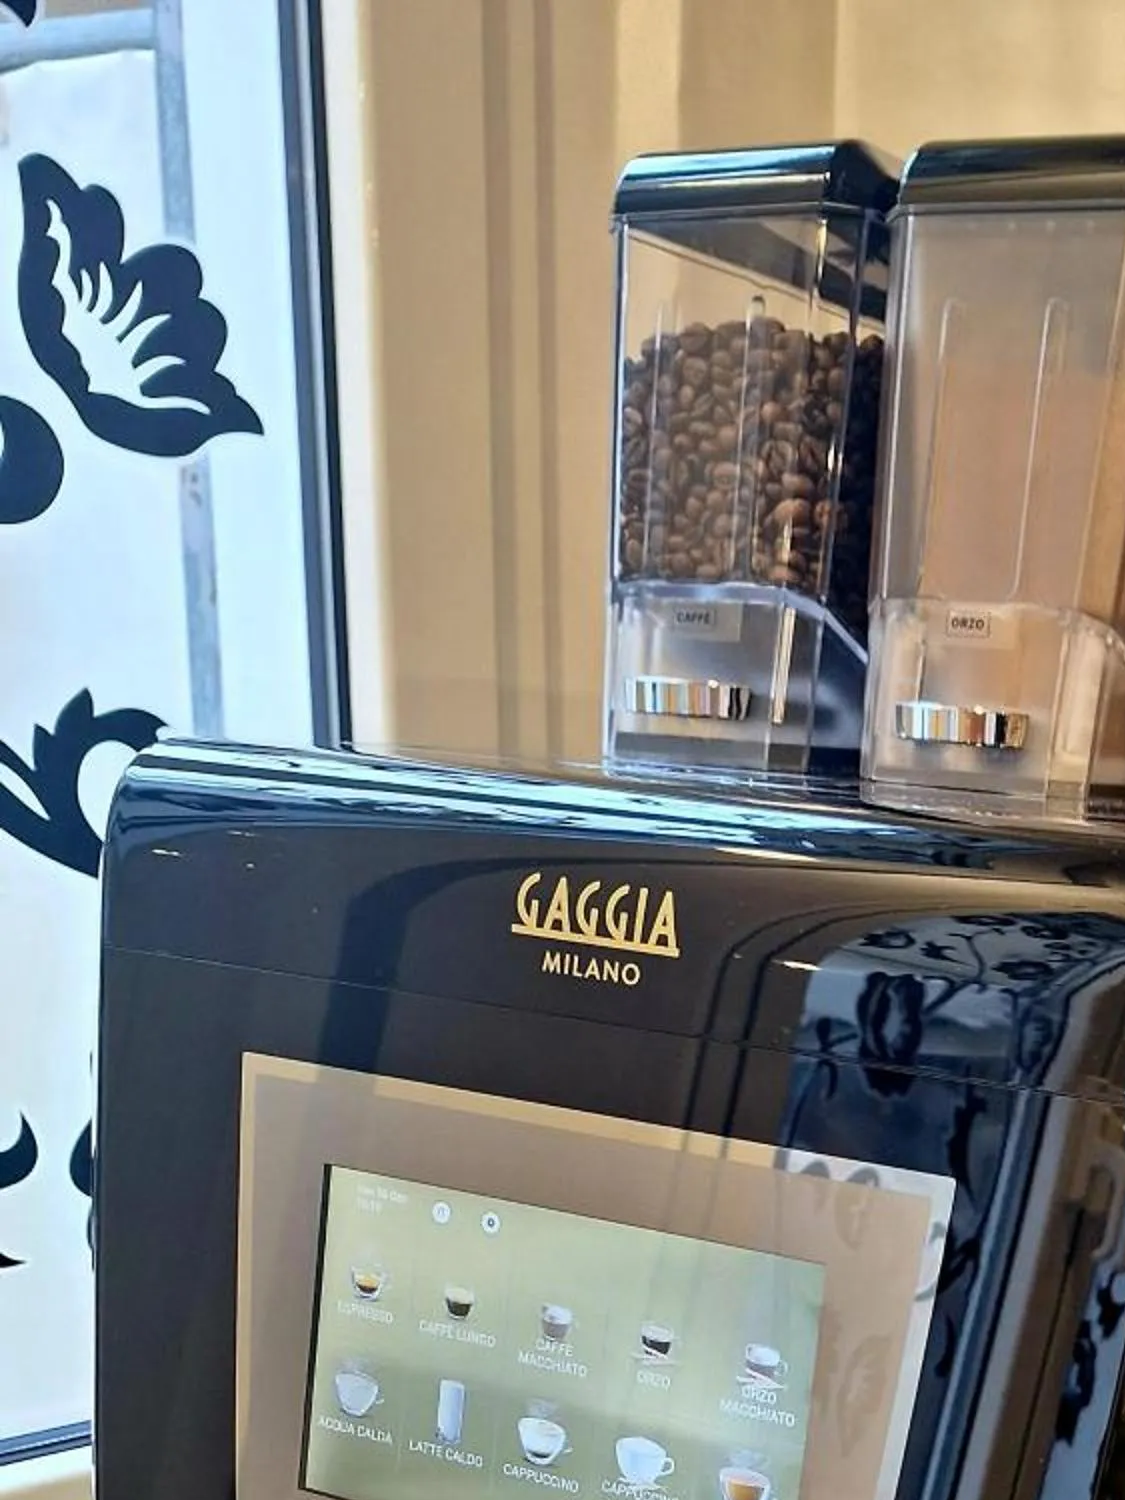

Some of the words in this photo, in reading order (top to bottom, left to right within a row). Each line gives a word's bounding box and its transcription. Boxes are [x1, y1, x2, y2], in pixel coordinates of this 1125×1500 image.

[951, 617, 985, 631] ORZO
[514, 872, 678, 953] GAGGIA
[542, 950, 640, 985] MILANO
[518, 1351, 588, 1378] MACCHIATO
[636, 1369, 672, 1389] ORZO
[742, 1385, 777, 1404] ORZO
[719, 1398, 795, 1427] MACCHIATO
[357, 1424, 393, 1446] CALDA
[409, 1439, 443, 1459] LATTE
[445, 1448, 484, 1467] CALDO
[503, 1463, 579, 1493] CAPPUCCINO
